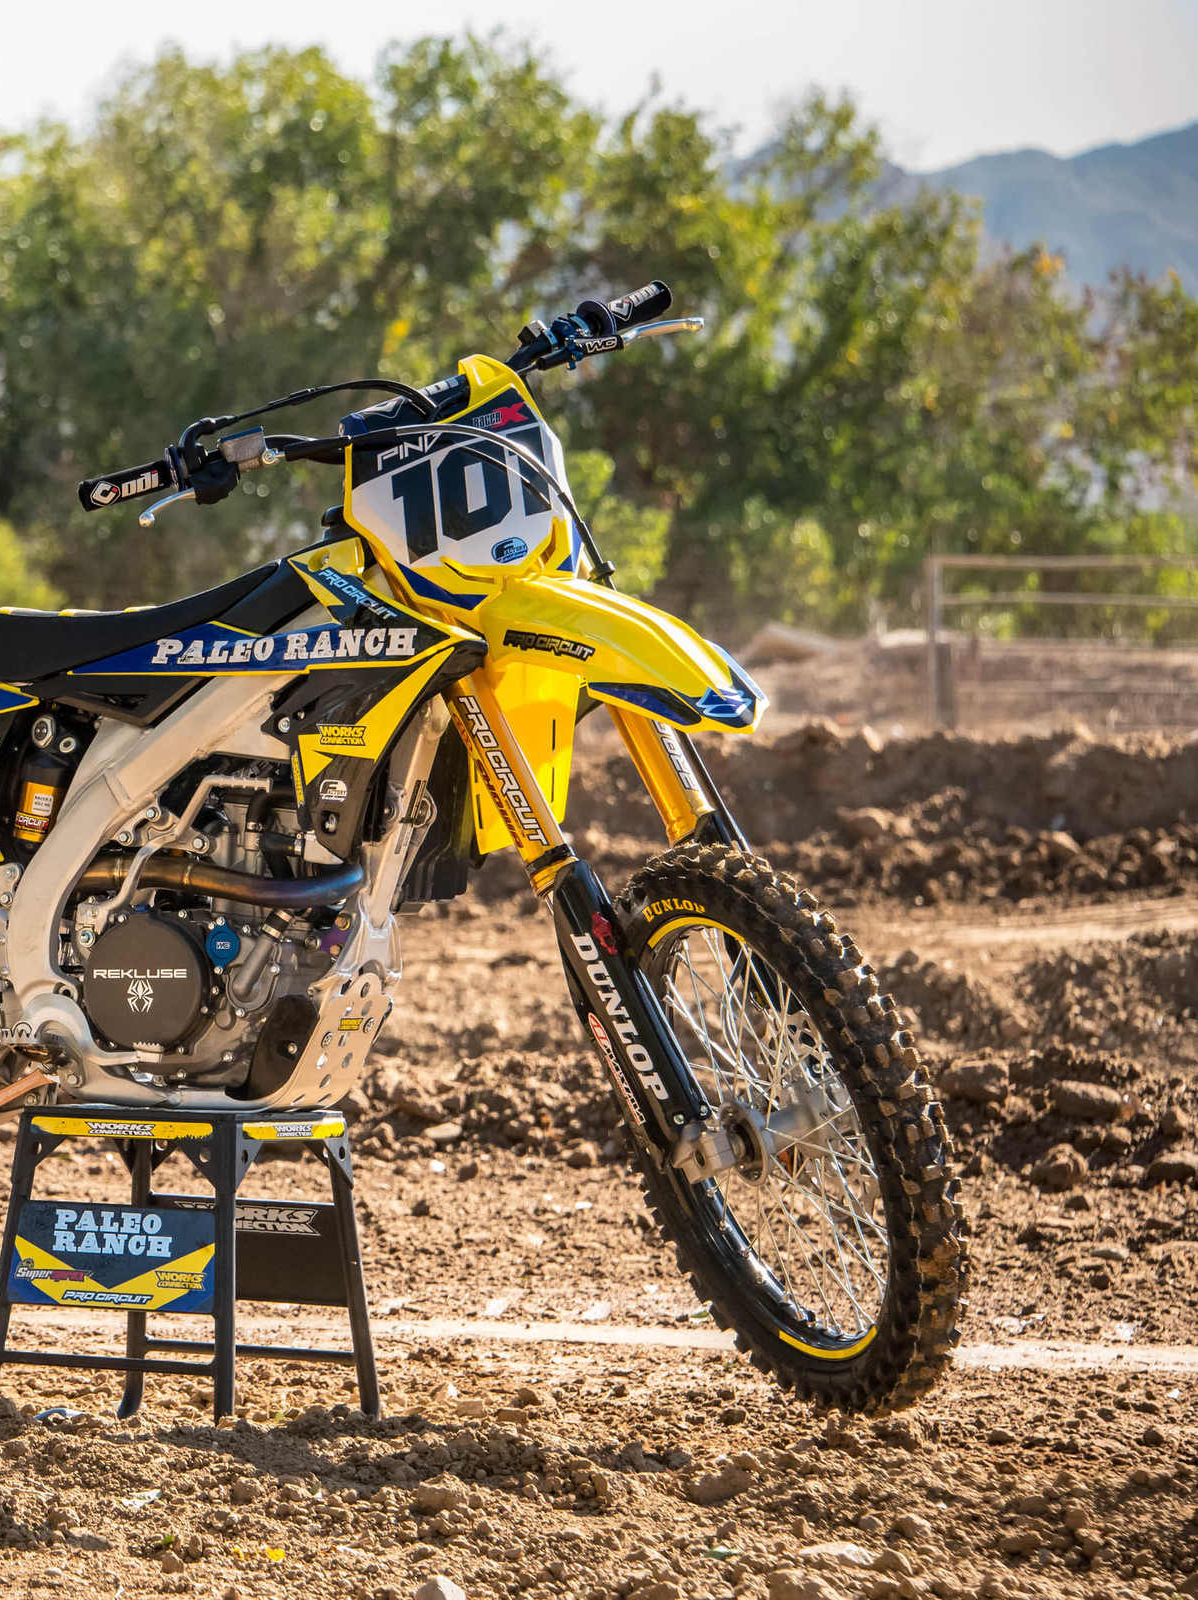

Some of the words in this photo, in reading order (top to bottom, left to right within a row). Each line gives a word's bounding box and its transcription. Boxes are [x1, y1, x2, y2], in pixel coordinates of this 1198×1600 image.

[586, 336, 617, 353] WC
[122, 470, 159, 497] odi
[391, 426, 552, 564] 101
[318, 569, 348, 594] PRO
[342, 583, 397, 620] CIRCUIT
[152, 637, 275, 664] PALEO
[284, 628, 418, 660] RANCH
[505, 632, 536, 652] PRO
[535, 637, 594, 659] CIRCUIT
[319, 726, 365, 737] WORKS
[320, 736, 364, 745] CONNECTION
[458, 695, 499, 750] PRO
[485, 749, 550, 846] CIRCUIT
[642, 898, 706, 923] DUNLOP
[93, 968, 188, 979] REKLUSE
[570, 932, 669, 1100] DUNLOP
[89, 1122, 155, 1131] WORKS
[54, 1208, 163, 1235] PALEO
[235, 1219, 314, 1234] NECTION
[52, 1230, 173, 1258] RANCH
[156, 1271, 204, 1283] WORKS
[157, 1280, 204, 1290] CONNECTION
[63, 1290, 95, 1304] PRO
[94, 1292, 152, 1305] CIRCUIT
